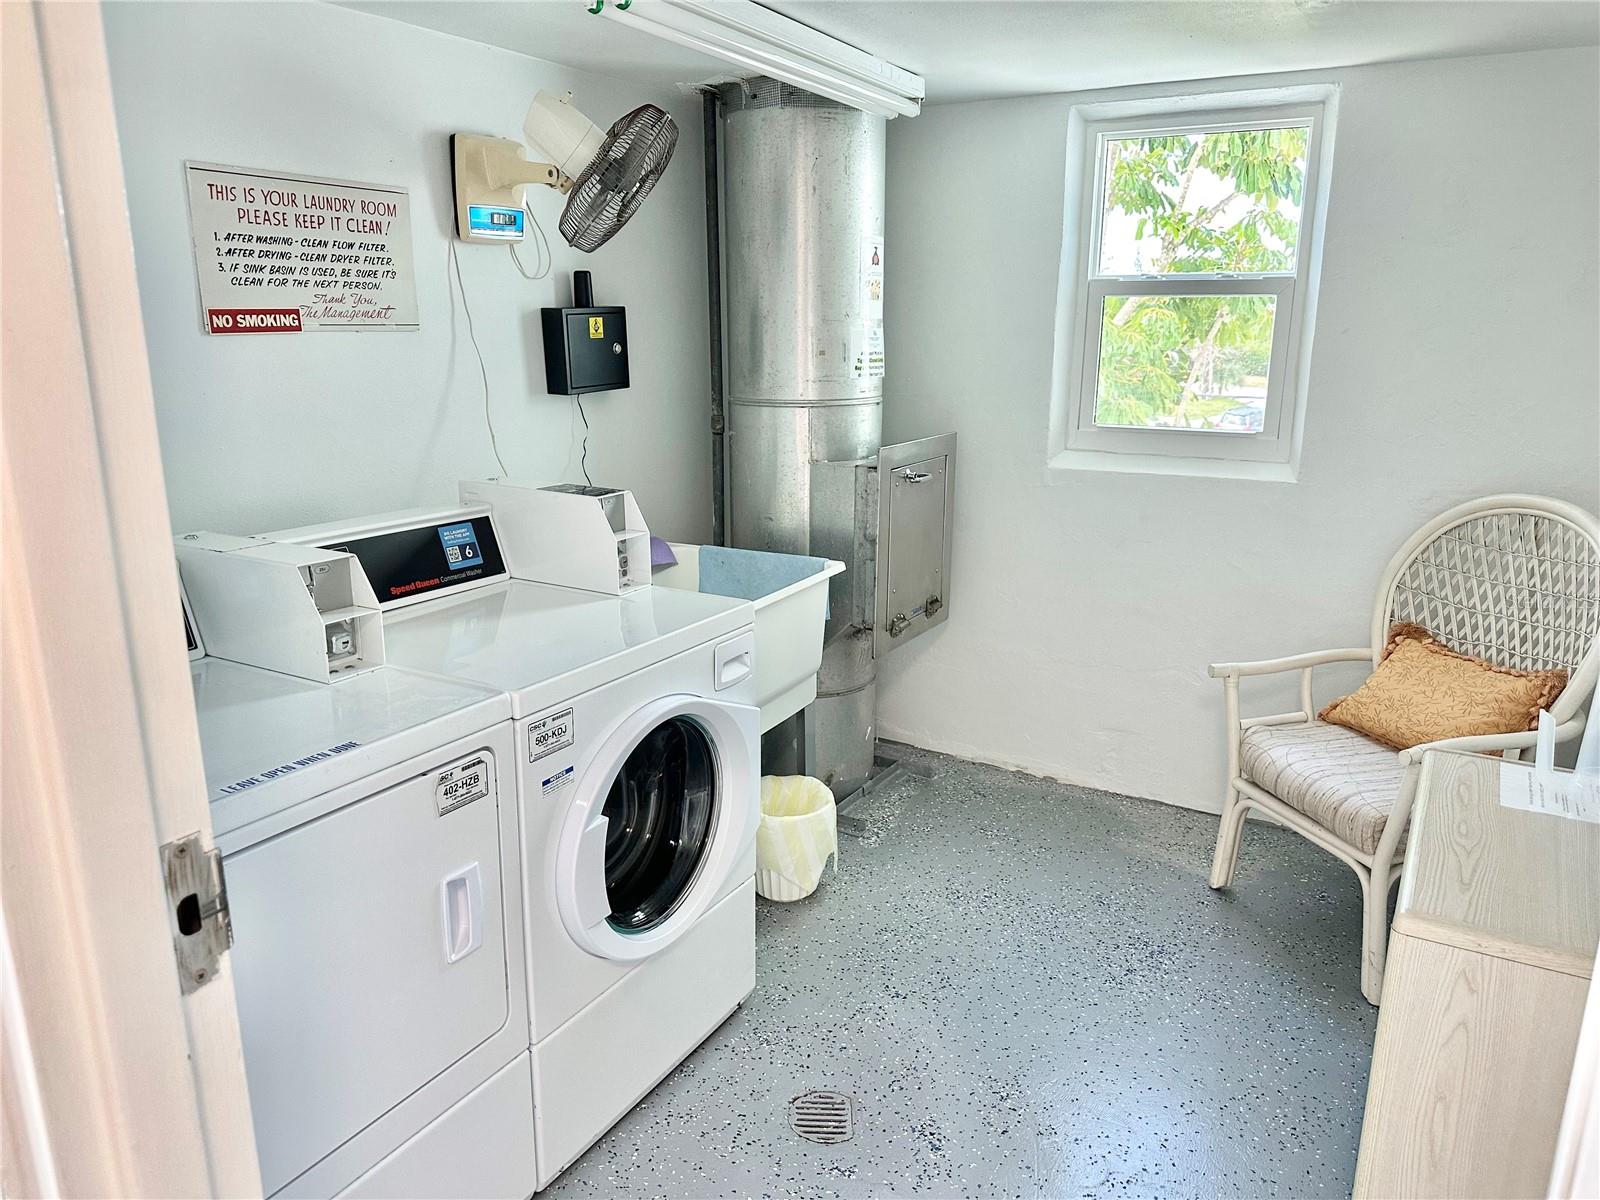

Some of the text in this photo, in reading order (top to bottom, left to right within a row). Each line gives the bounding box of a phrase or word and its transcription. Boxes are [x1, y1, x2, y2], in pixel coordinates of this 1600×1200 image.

[207, 184, 397, 217] THIS IS YOUR LAUNDRY ROOM
[238, 208, 288, 227] PLEASE
[295, 214, 324, 229] KEEP
[331, 217, 341, 231] IT
[214, 232, 220, 241] 1.
[224, 233, 253, 244] AFTER
[256, 235, 293, 246] WASHING
[300, 238, 328, 248] CLEAN
[332, 240, 355, 250] FLOW
[359, 242, 389, 252] FILTER.
[225, 249, 255, 258] AFTER
[258, 250, 292, 261] DRYING
[300, 252, 327, 262] CLEAN
[331, 254, 359, 265] DRYER
[363, 257, 394, 266] FILTER.
[218, 263, 226, 272] 3.
[229, 263, 239, 273] IF
[244, 264, 266, 274] SINK
[269, 266, 296, 275] BASIN
[300, 267, 308, 275] IS
[312, 268, 337, 277] USED,
[340, 269, 351, 277] BE
[355, 270, 379, 278] SURE
[231, 277, 382, 290] CLEAN FOR THE NEXT PERSON.
[312, 294, 346, 304] Thank
[212, 314, 298, 327] NO SMOKING
[318, 305, 396, 320] Management
[466, 546, 473, 558] 6
[390, 583, 416, 594] Speed
[416, 578, 440, 588] Queen
[536, 725, 567, 746] 500-KDJ
[220, 741, 361, 794] LEAVE OPEN WHEN DONE
[443, 774, 480, 796] 402-HZB
